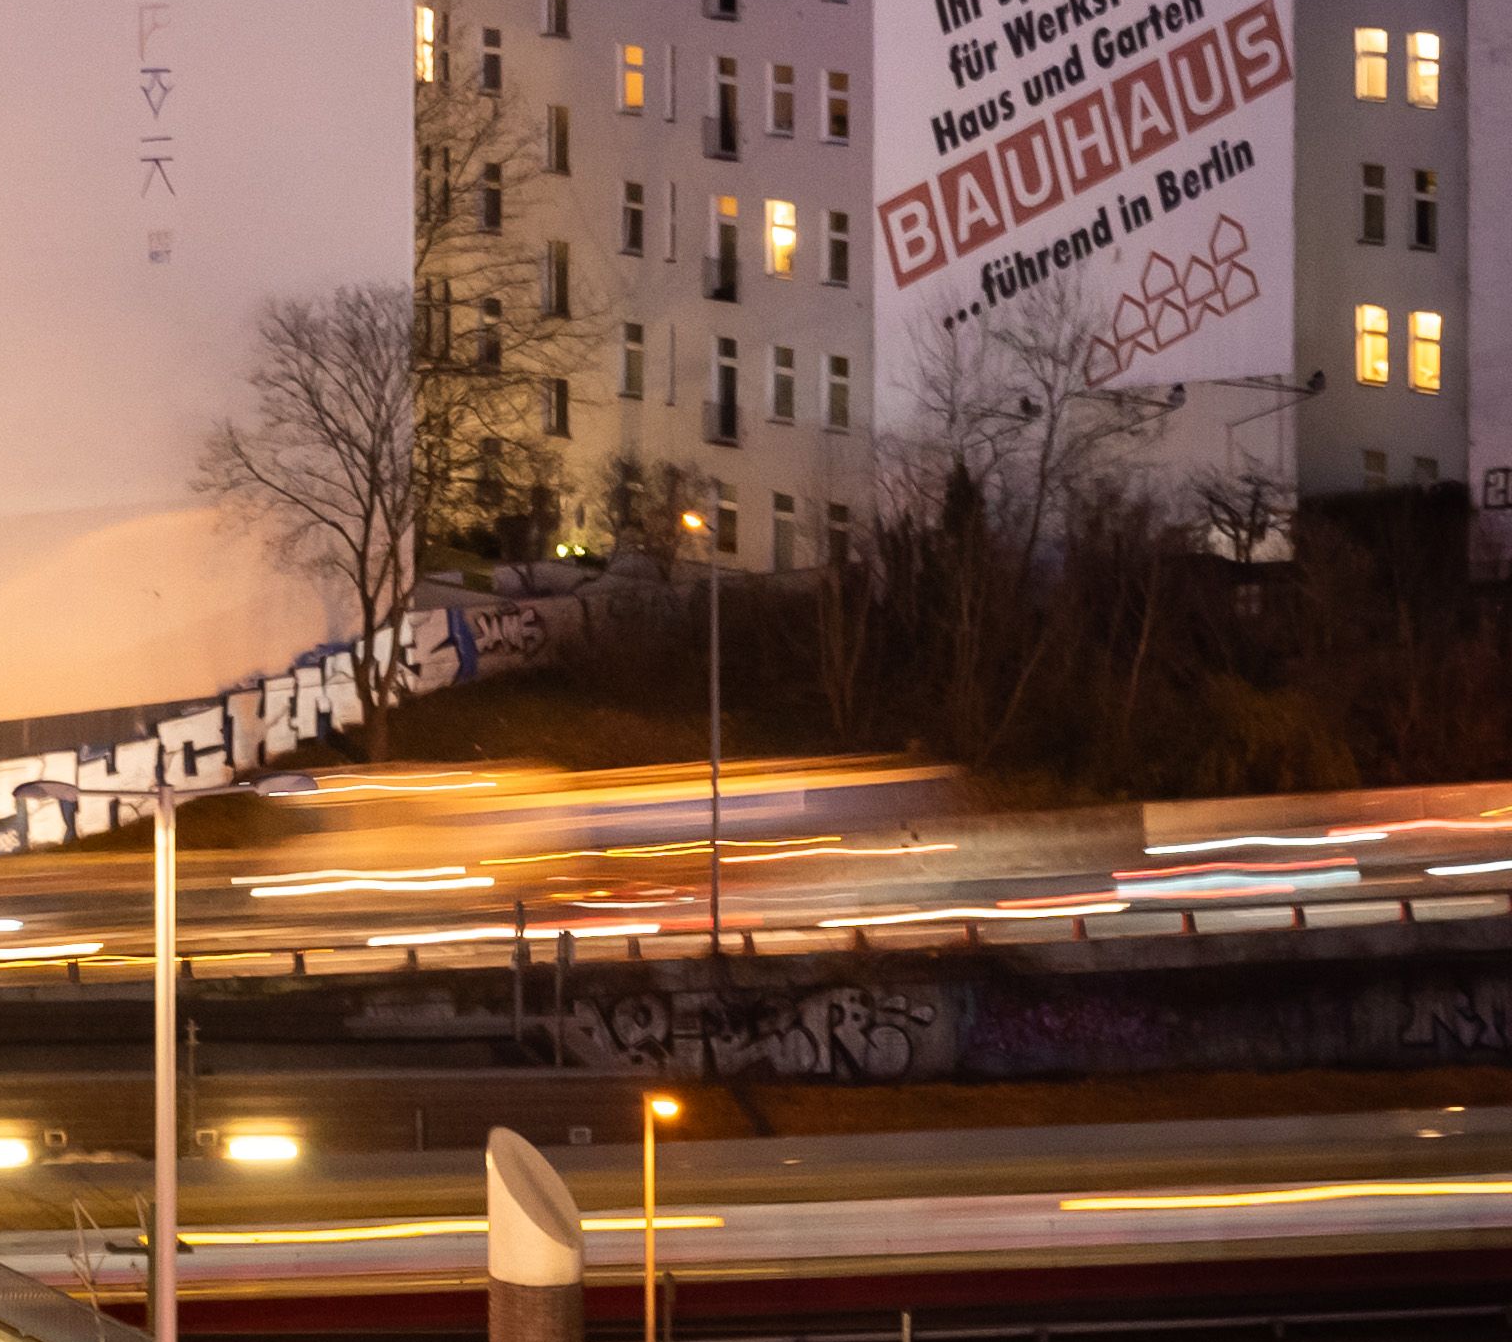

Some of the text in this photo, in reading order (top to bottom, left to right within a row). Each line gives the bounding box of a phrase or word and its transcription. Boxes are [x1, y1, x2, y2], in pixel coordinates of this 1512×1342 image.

[931, 90, 1016, 157] Haus
[1022, 45, 1086, 107] und
[948, 38, 998, 89] für
[884, 9, 1288, 279] BAUHAUS
[1117, 194, 1153, 234] in
[1154, 139, 1256, 212] Berlin
